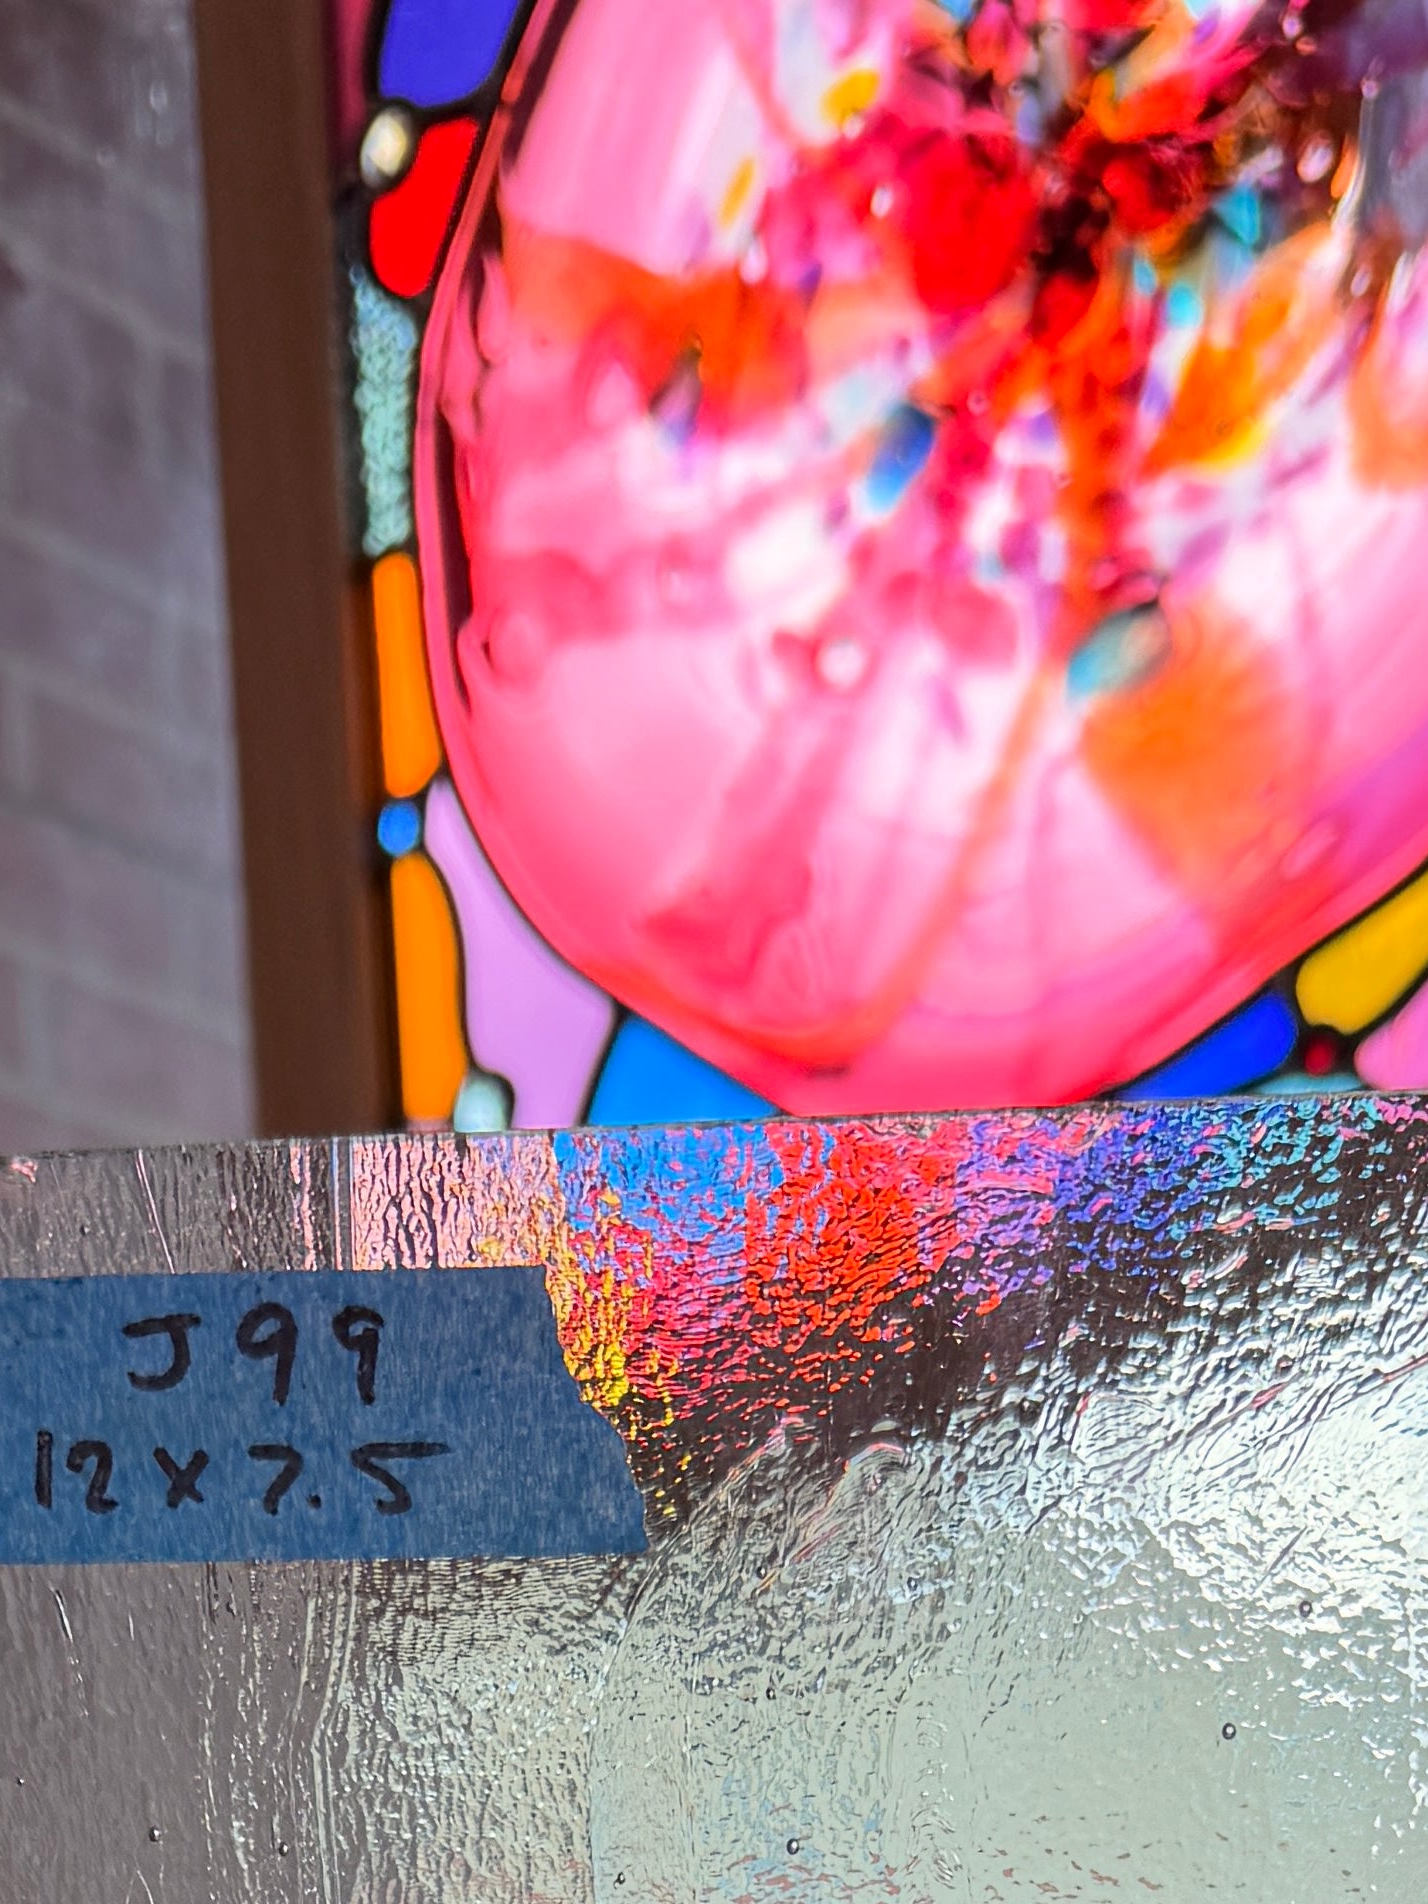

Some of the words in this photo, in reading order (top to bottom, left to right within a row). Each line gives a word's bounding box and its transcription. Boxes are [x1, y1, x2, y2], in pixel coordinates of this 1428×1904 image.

[120, 1301, 386, 1406] J99
[34, 1429, 120, 1515] 12
[246, 1440, 454, 1517] 7.5
